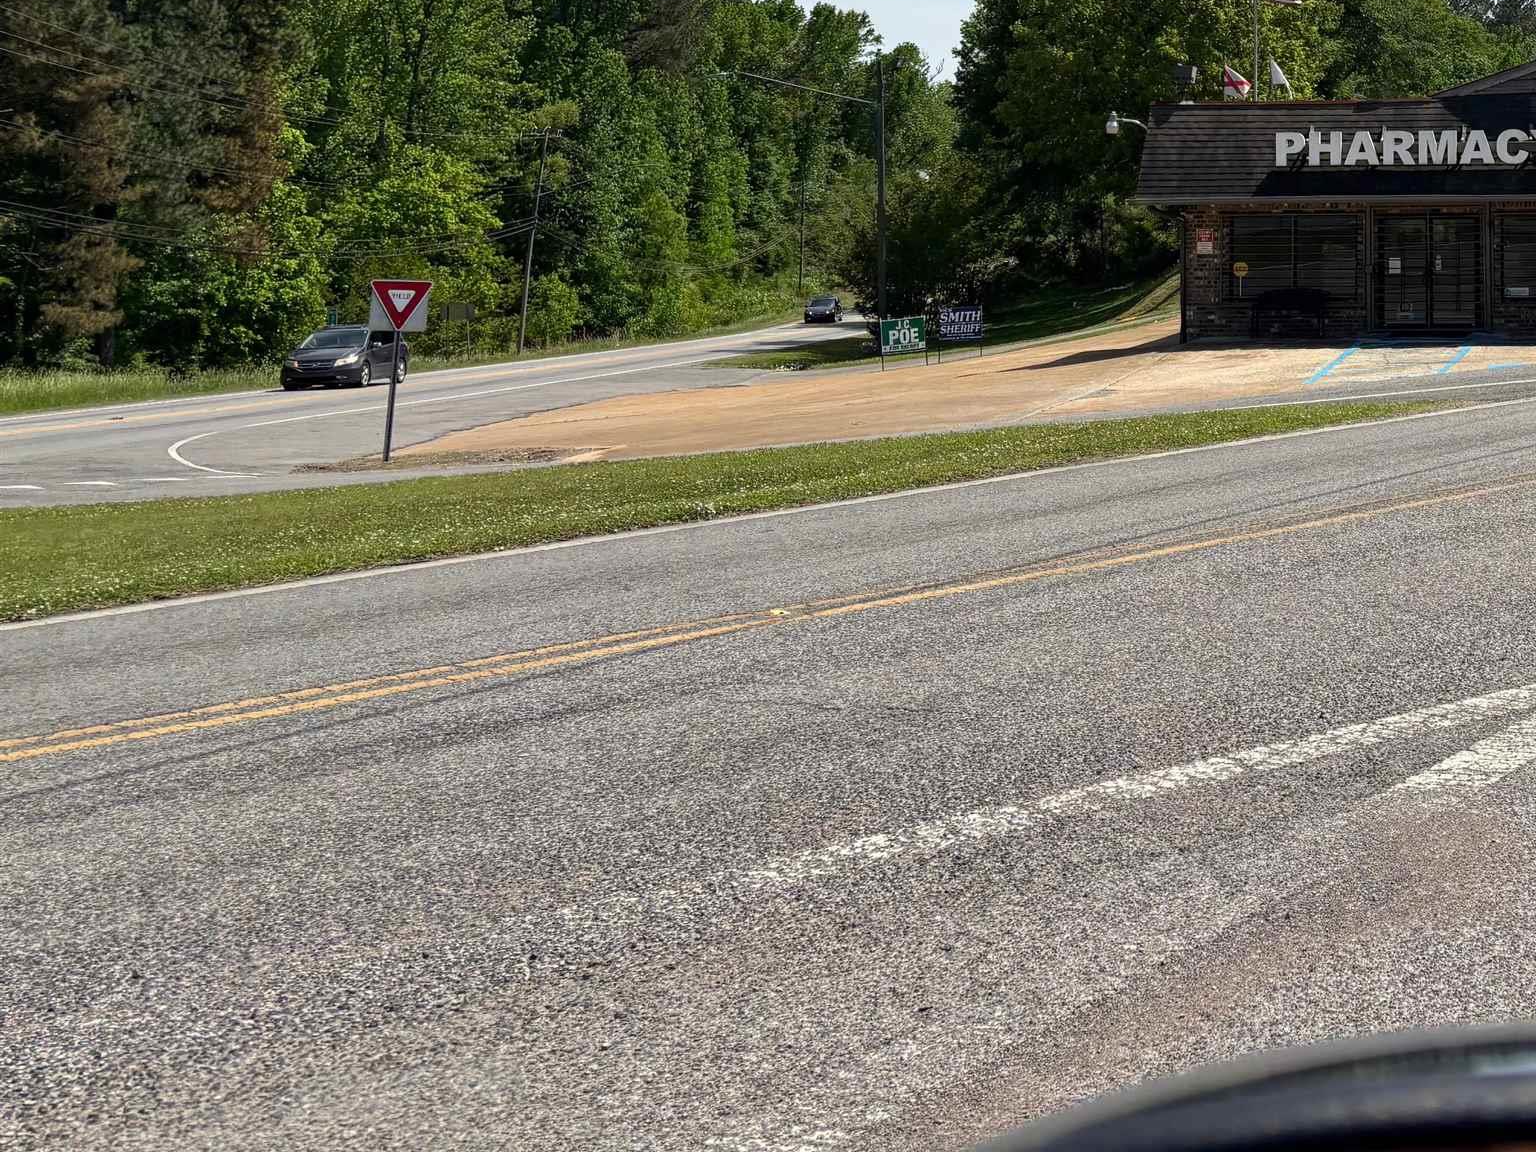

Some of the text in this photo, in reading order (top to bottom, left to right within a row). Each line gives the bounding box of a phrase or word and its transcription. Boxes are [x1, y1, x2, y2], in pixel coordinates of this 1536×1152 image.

[939, 311, 980, 323] SMITH
[939, 324, 981, 334] SHERIFF
[889, 328, 919, 345] POE
